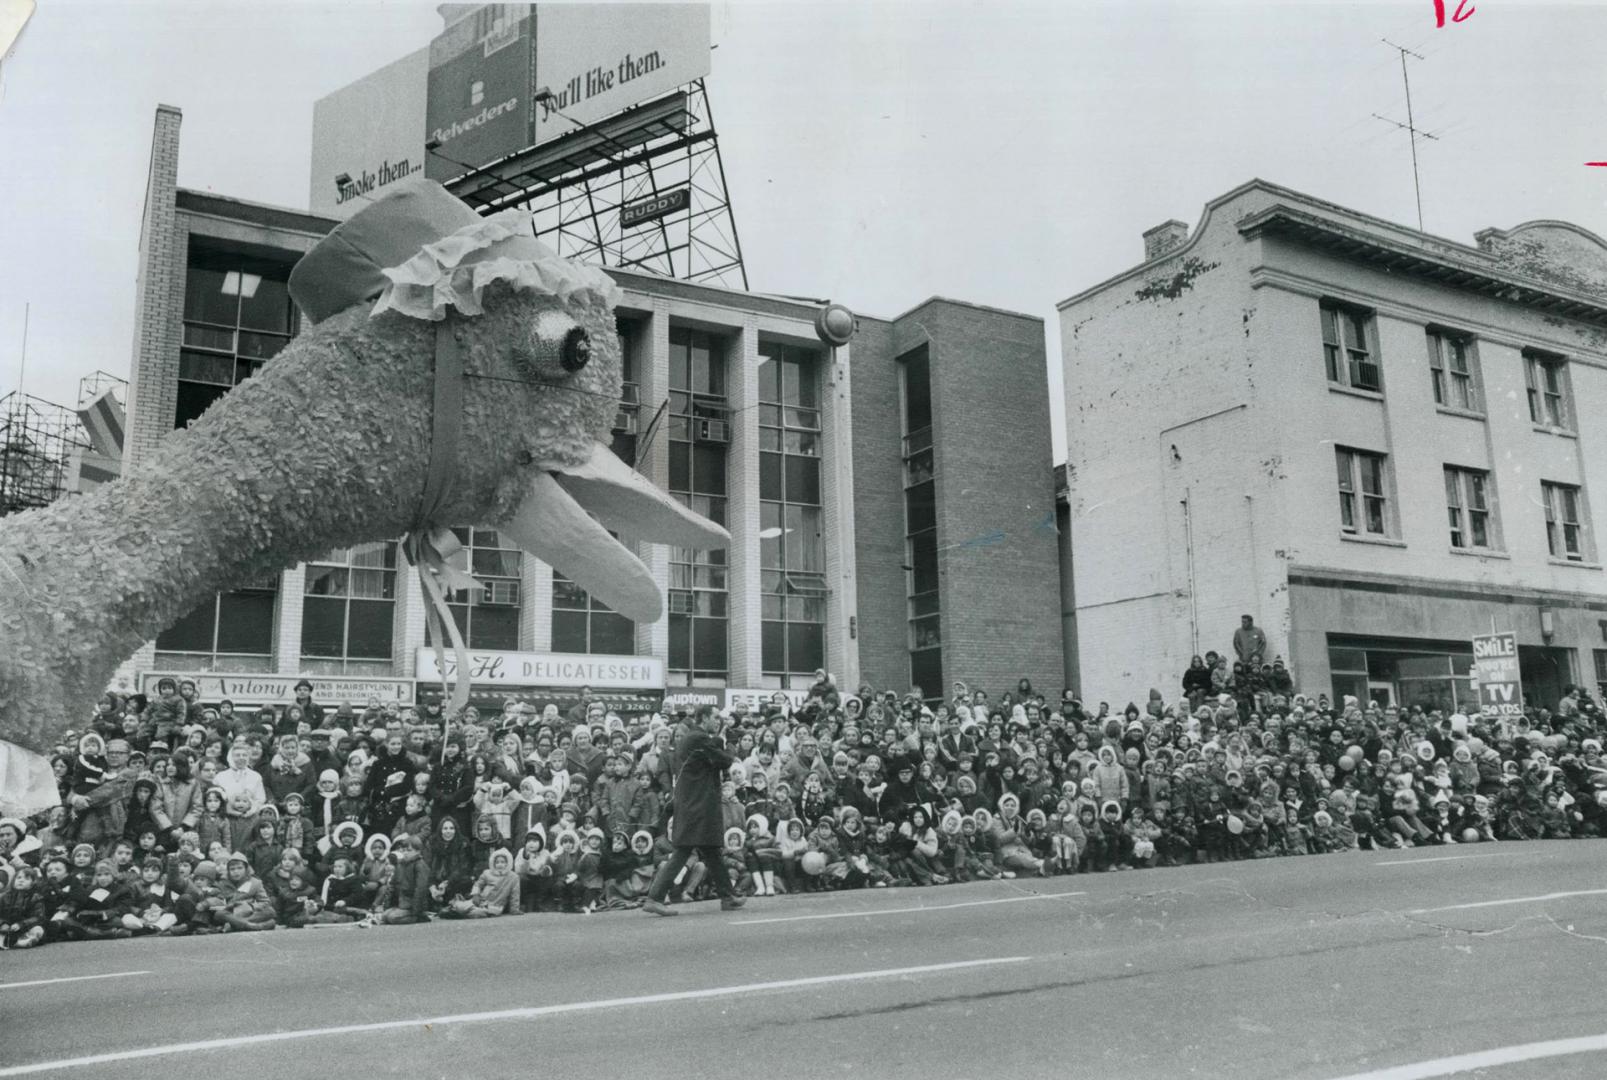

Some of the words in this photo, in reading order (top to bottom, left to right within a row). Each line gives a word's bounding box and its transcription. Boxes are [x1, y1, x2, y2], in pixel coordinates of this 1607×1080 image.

[586, 66, 614, 98] like
[618, 50, 666, 84] them.
[432, 97, 518, 141] Belvedere
[336, 170, 376, 205] Smoke
[378, 159, 422, 187] them...
[624, 194, 679, 221] RUDDY
[522, 661, 651, 681] DELICATESSEN
[1489, 671, 1506, 681] ON
[211, 679, 287, 698] Antony
[336, 682, 393, 691] HAIRSTYLING
[1486, 683, 1514, 702] TV
[673, 692, 718, 706] uptown
